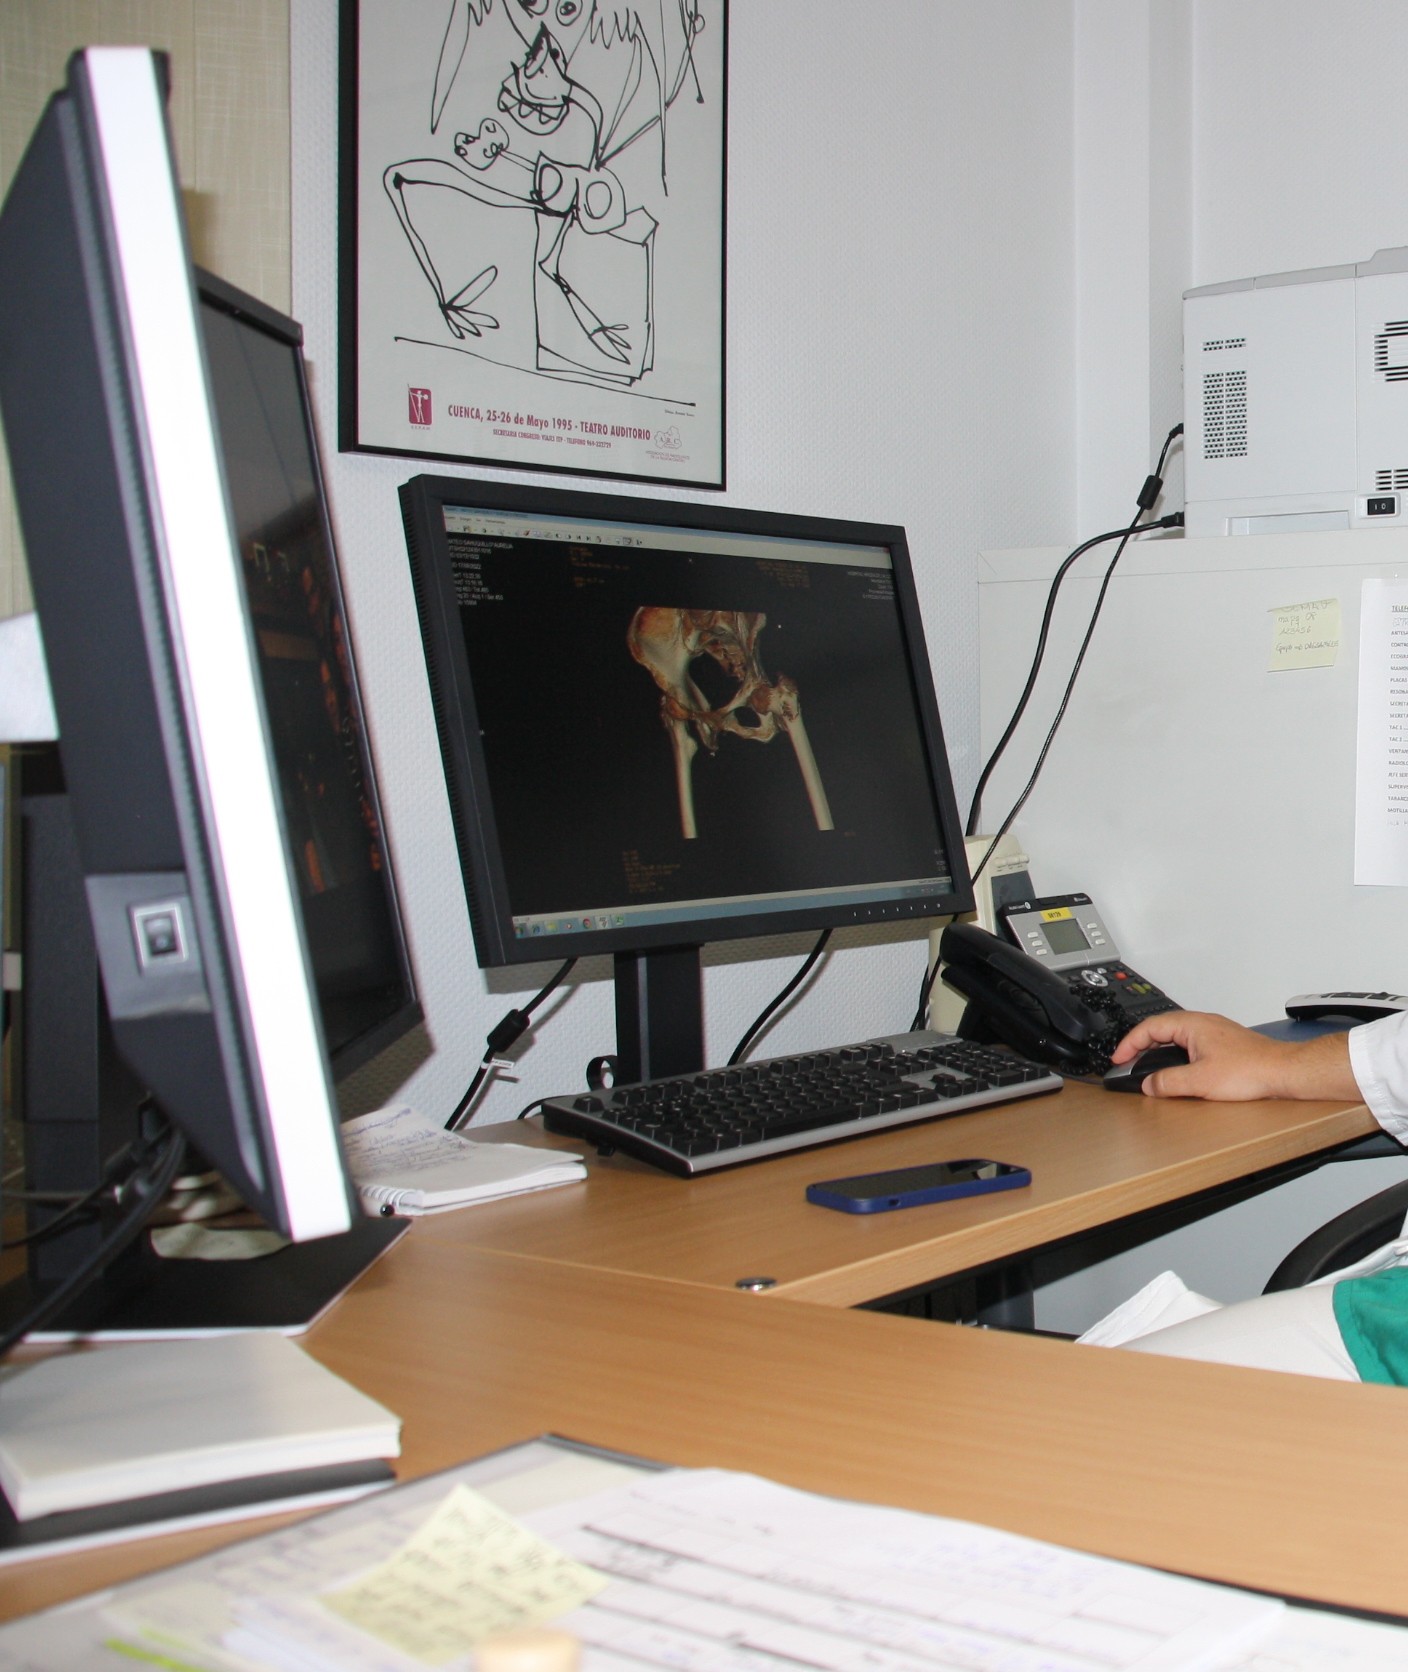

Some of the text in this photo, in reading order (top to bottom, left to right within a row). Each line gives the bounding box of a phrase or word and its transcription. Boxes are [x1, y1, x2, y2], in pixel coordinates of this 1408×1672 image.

[448, 405, 483, 422] CUENCA,
[486, 409, 511, 424] 25-26
[514, 412, 524, 425] de
[527, 414, 549, 431] Mayo
[552, 417, 573, 431] 1995
[580, 421, 608, 435] TEATRO
[610, 424, 651, 441] AUDITORIO
